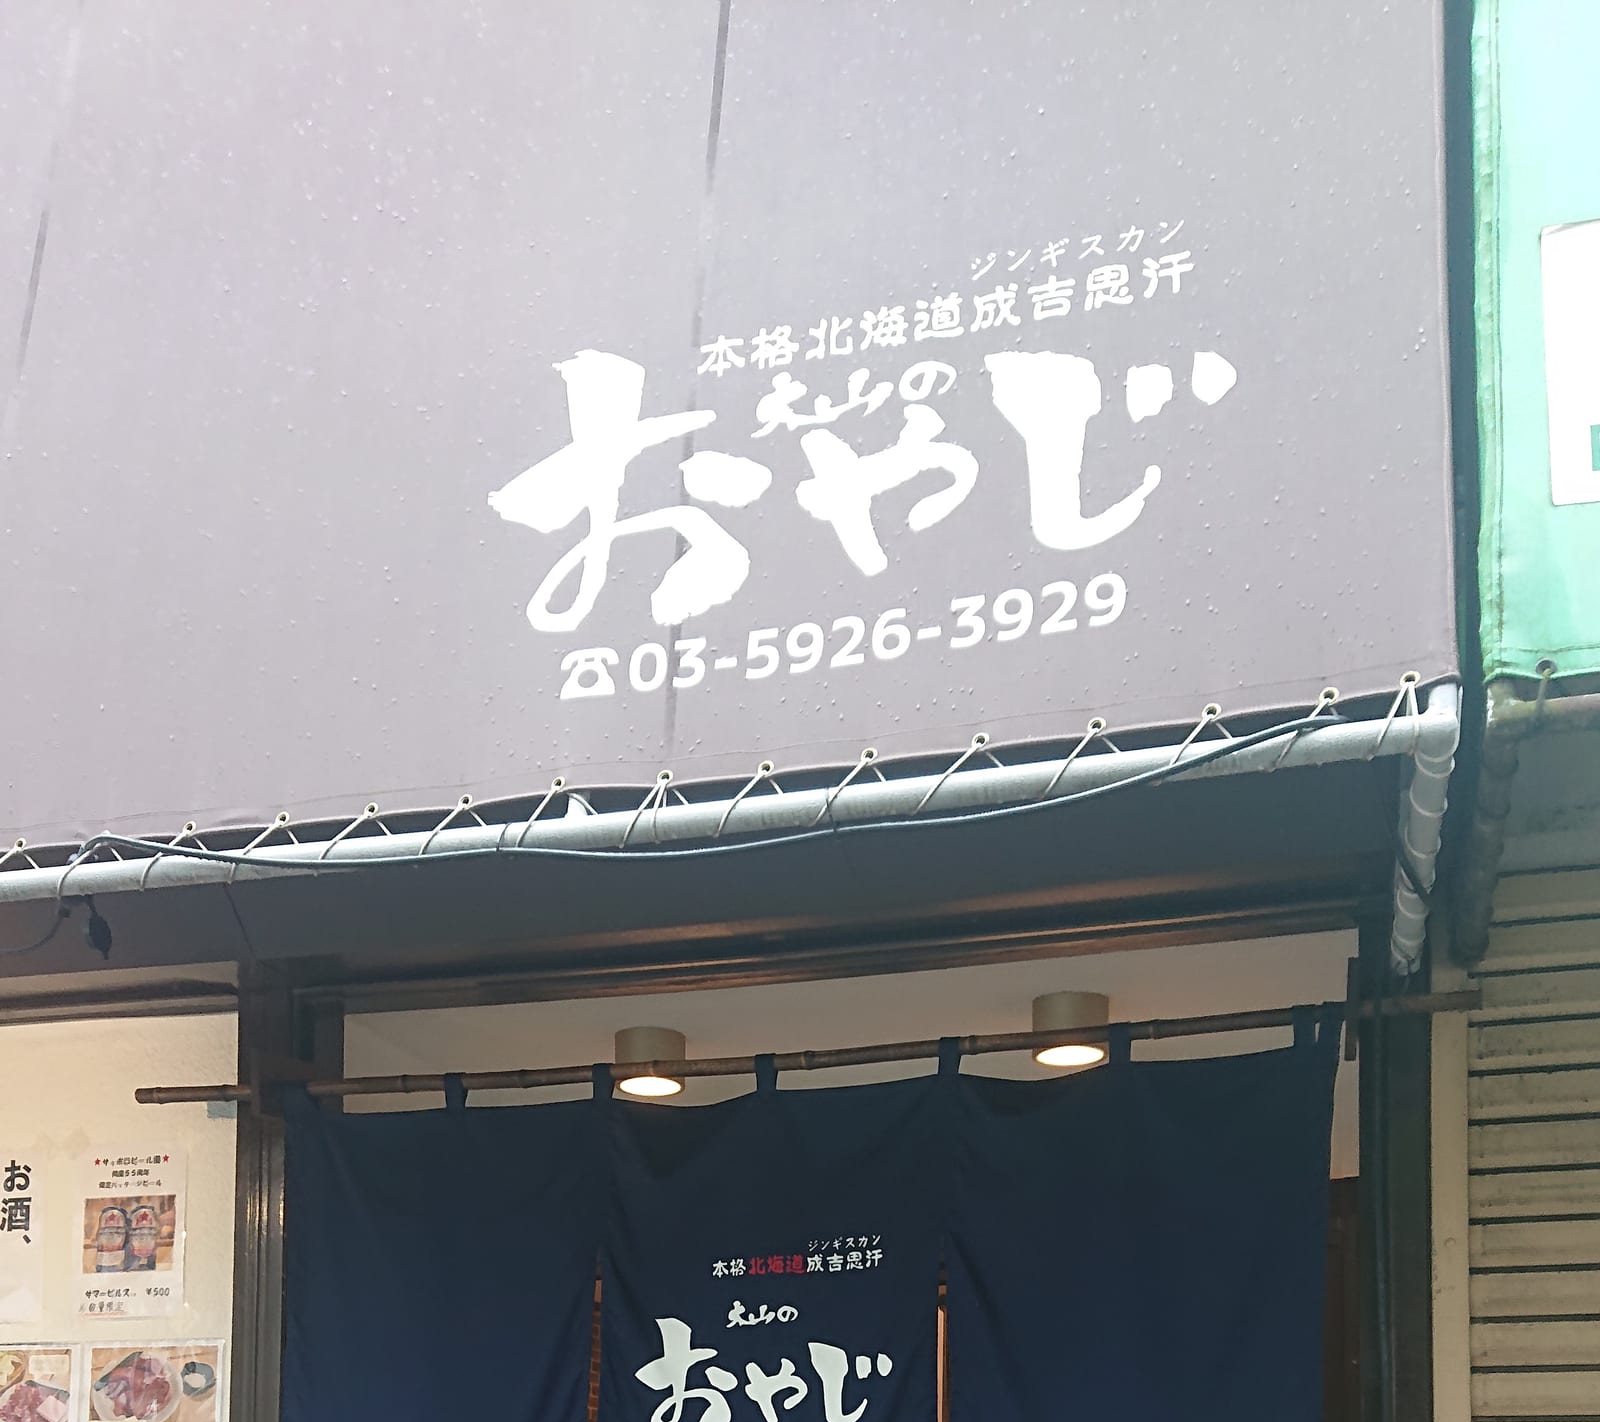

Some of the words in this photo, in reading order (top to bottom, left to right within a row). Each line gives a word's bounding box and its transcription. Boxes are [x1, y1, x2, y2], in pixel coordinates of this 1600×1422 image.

[970, 219, 1186, 282] ジンギスカン
[696, 250, 1195, 378] 本格北海道成吉思汗
[751, 361, 957, 439] 大山の
[488, 349, 1238, 634] おやじ
[628, 572, 1128, 692] 03-5926-3929
[712, 1248, 883, 1279] 本格北海道成吉思汗
[807, 1233, 882, 1252] ジンギスカン
[725, 1300, 799, 1328] 大山の
